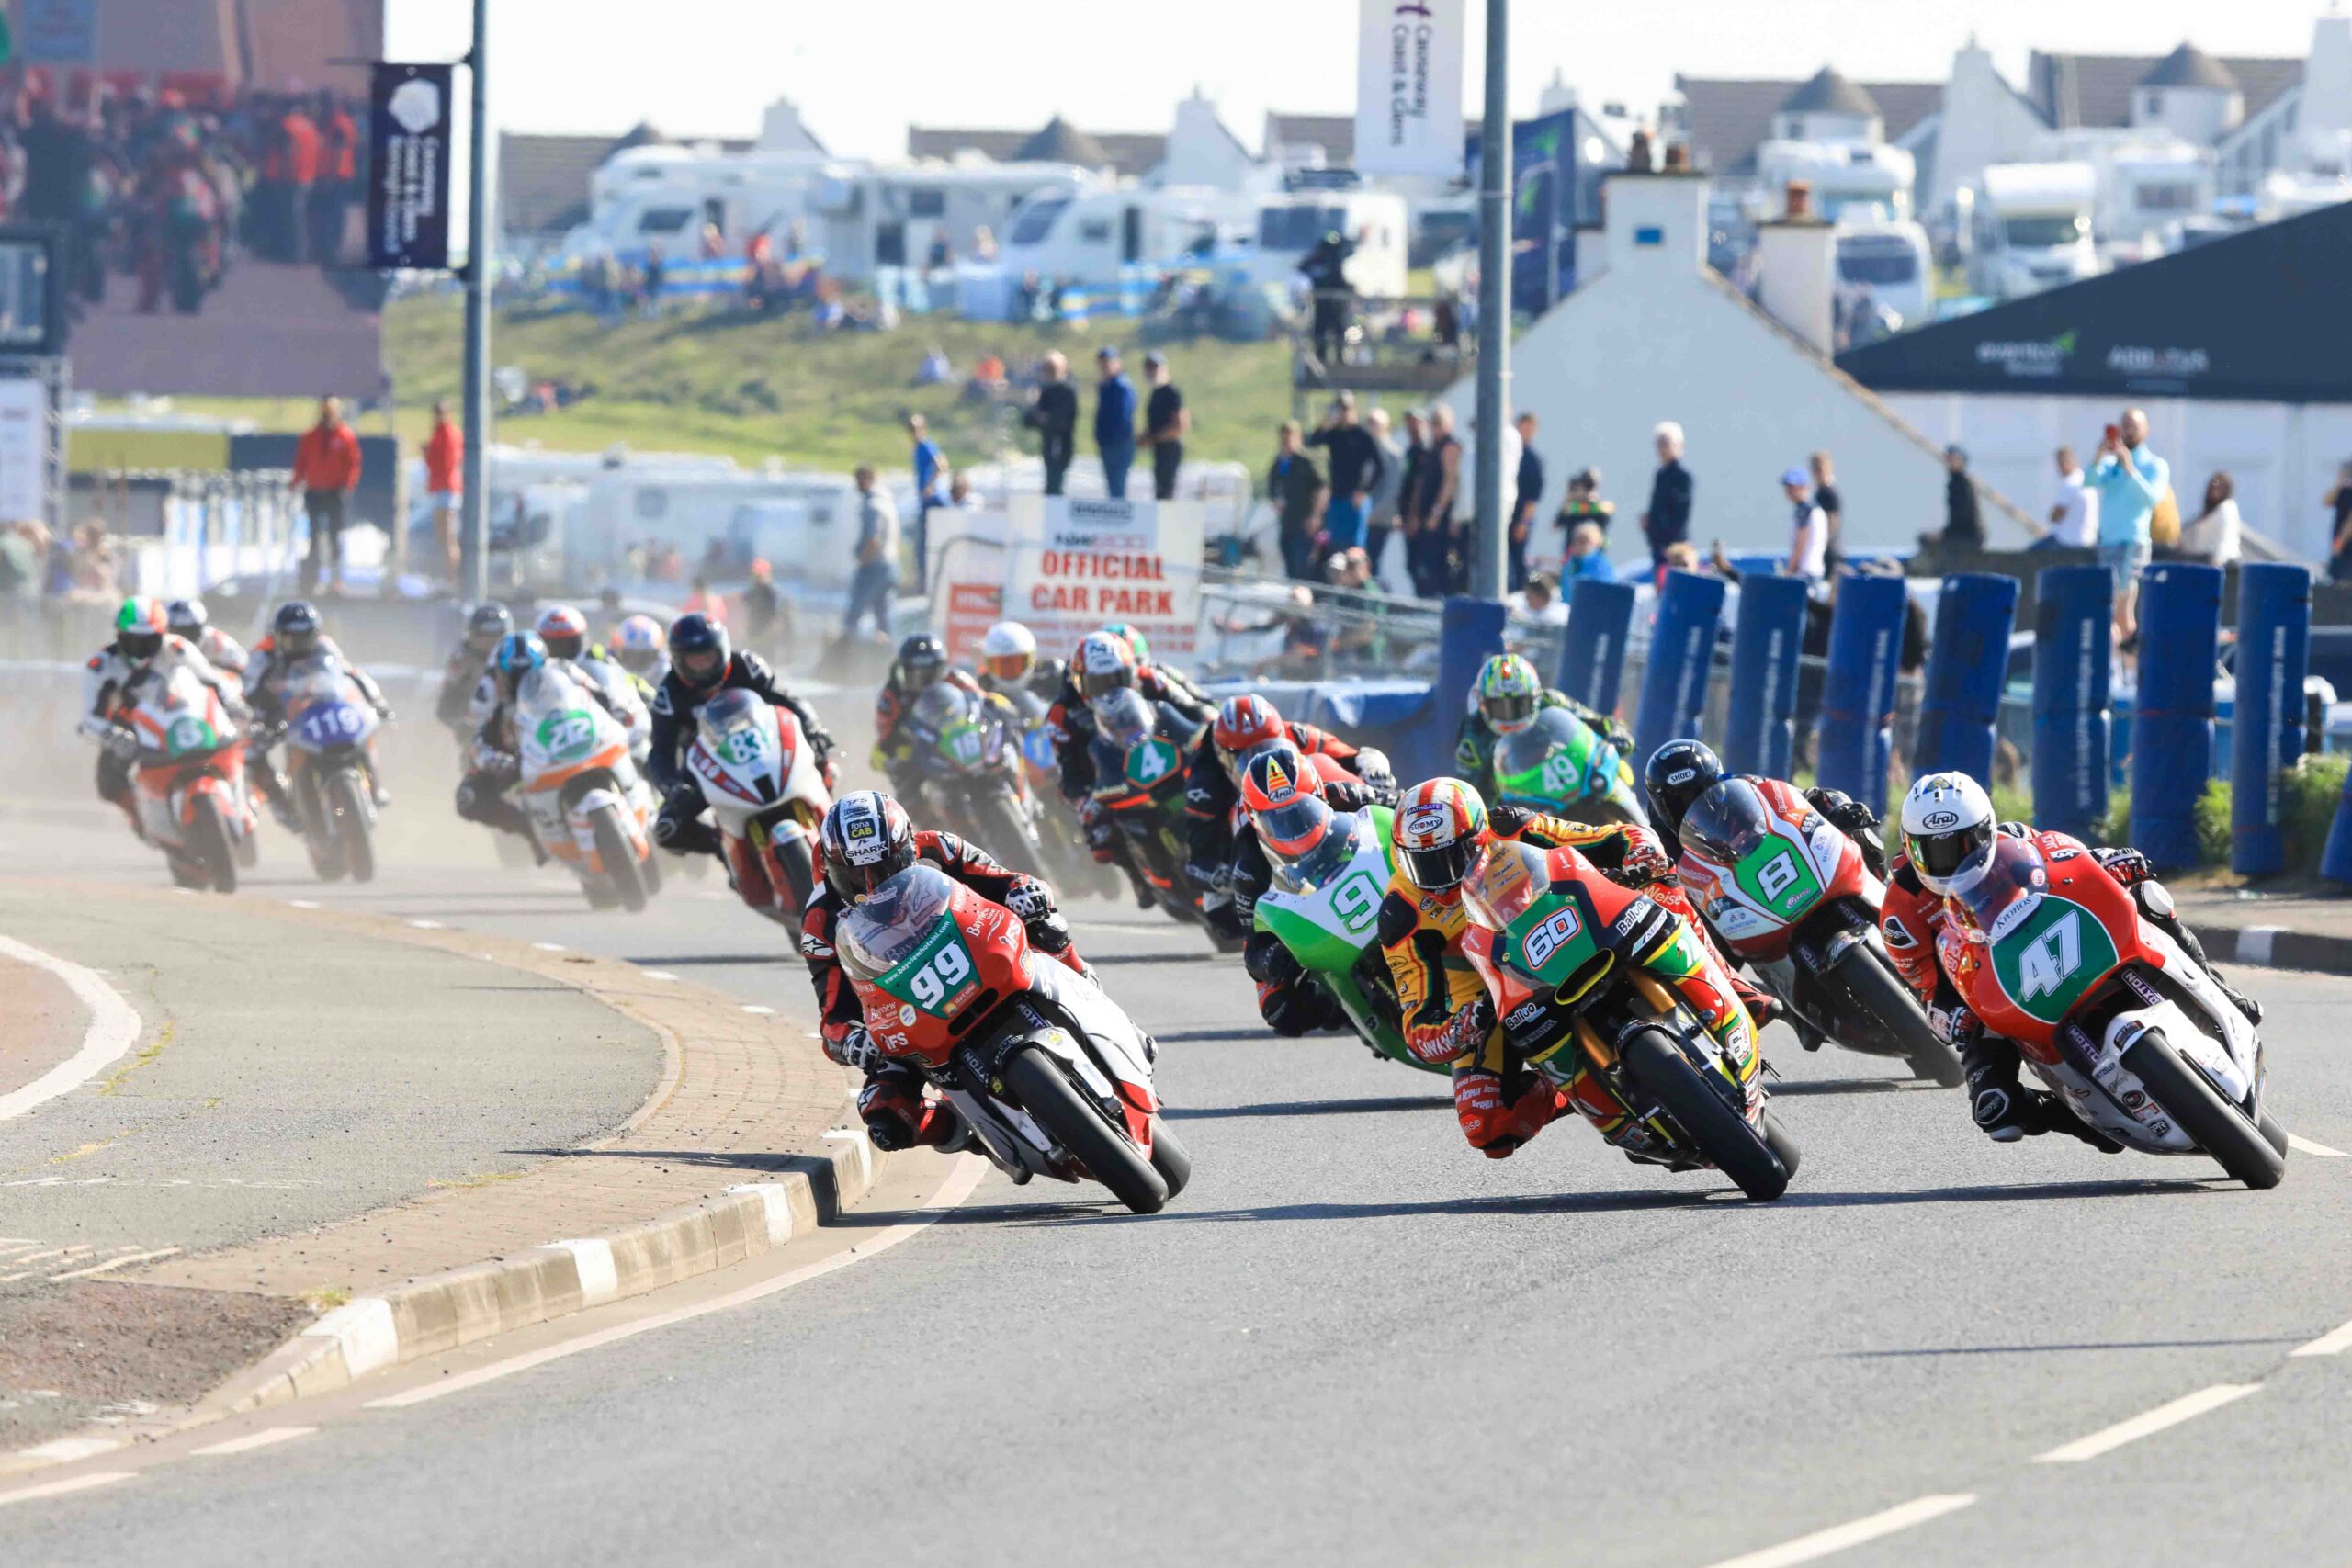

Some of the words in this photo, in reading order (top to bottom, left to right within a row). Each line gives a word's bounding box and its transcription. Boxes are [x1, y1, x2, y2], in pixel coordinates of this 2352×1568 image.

[1409, 25, 1432, 118] Causeway
[1042, 551, 1165, 580] OFFICIAL
[1031, 585, 1088, 612] CAR
[1099, 589, 1173, 615] PARK
[1140, 741, 1167, 778] 4
[1543, 754, 1579, 792] 49
[1670, 771, 1692, 783] SHOEI
[851, 821, 870, 829] fona
[851, 827, 873, 838] CAB
[1927, 812, 1955, 825] Arai
[846, 843, 887, 857] SHARK
[1757, 849, 1800, 905] 8
[1329, 870, 1385, 934] 9
[1645, 886, 1682, 906] Weise
[1616, 901, 1645, 936] Balloo
[1524, 908, 1580, 967] 60
[2020, 909, 2080, 1002] 47
[910, 939, 970, 1009] 99
[2125, 971, 2161, 1005] AXTON
[1505, 1003, 1537, 1030] Balloo
[2068, 1028, 2101, 1062] MAXTO
[1464, 1120, 1480, 1132] eise
